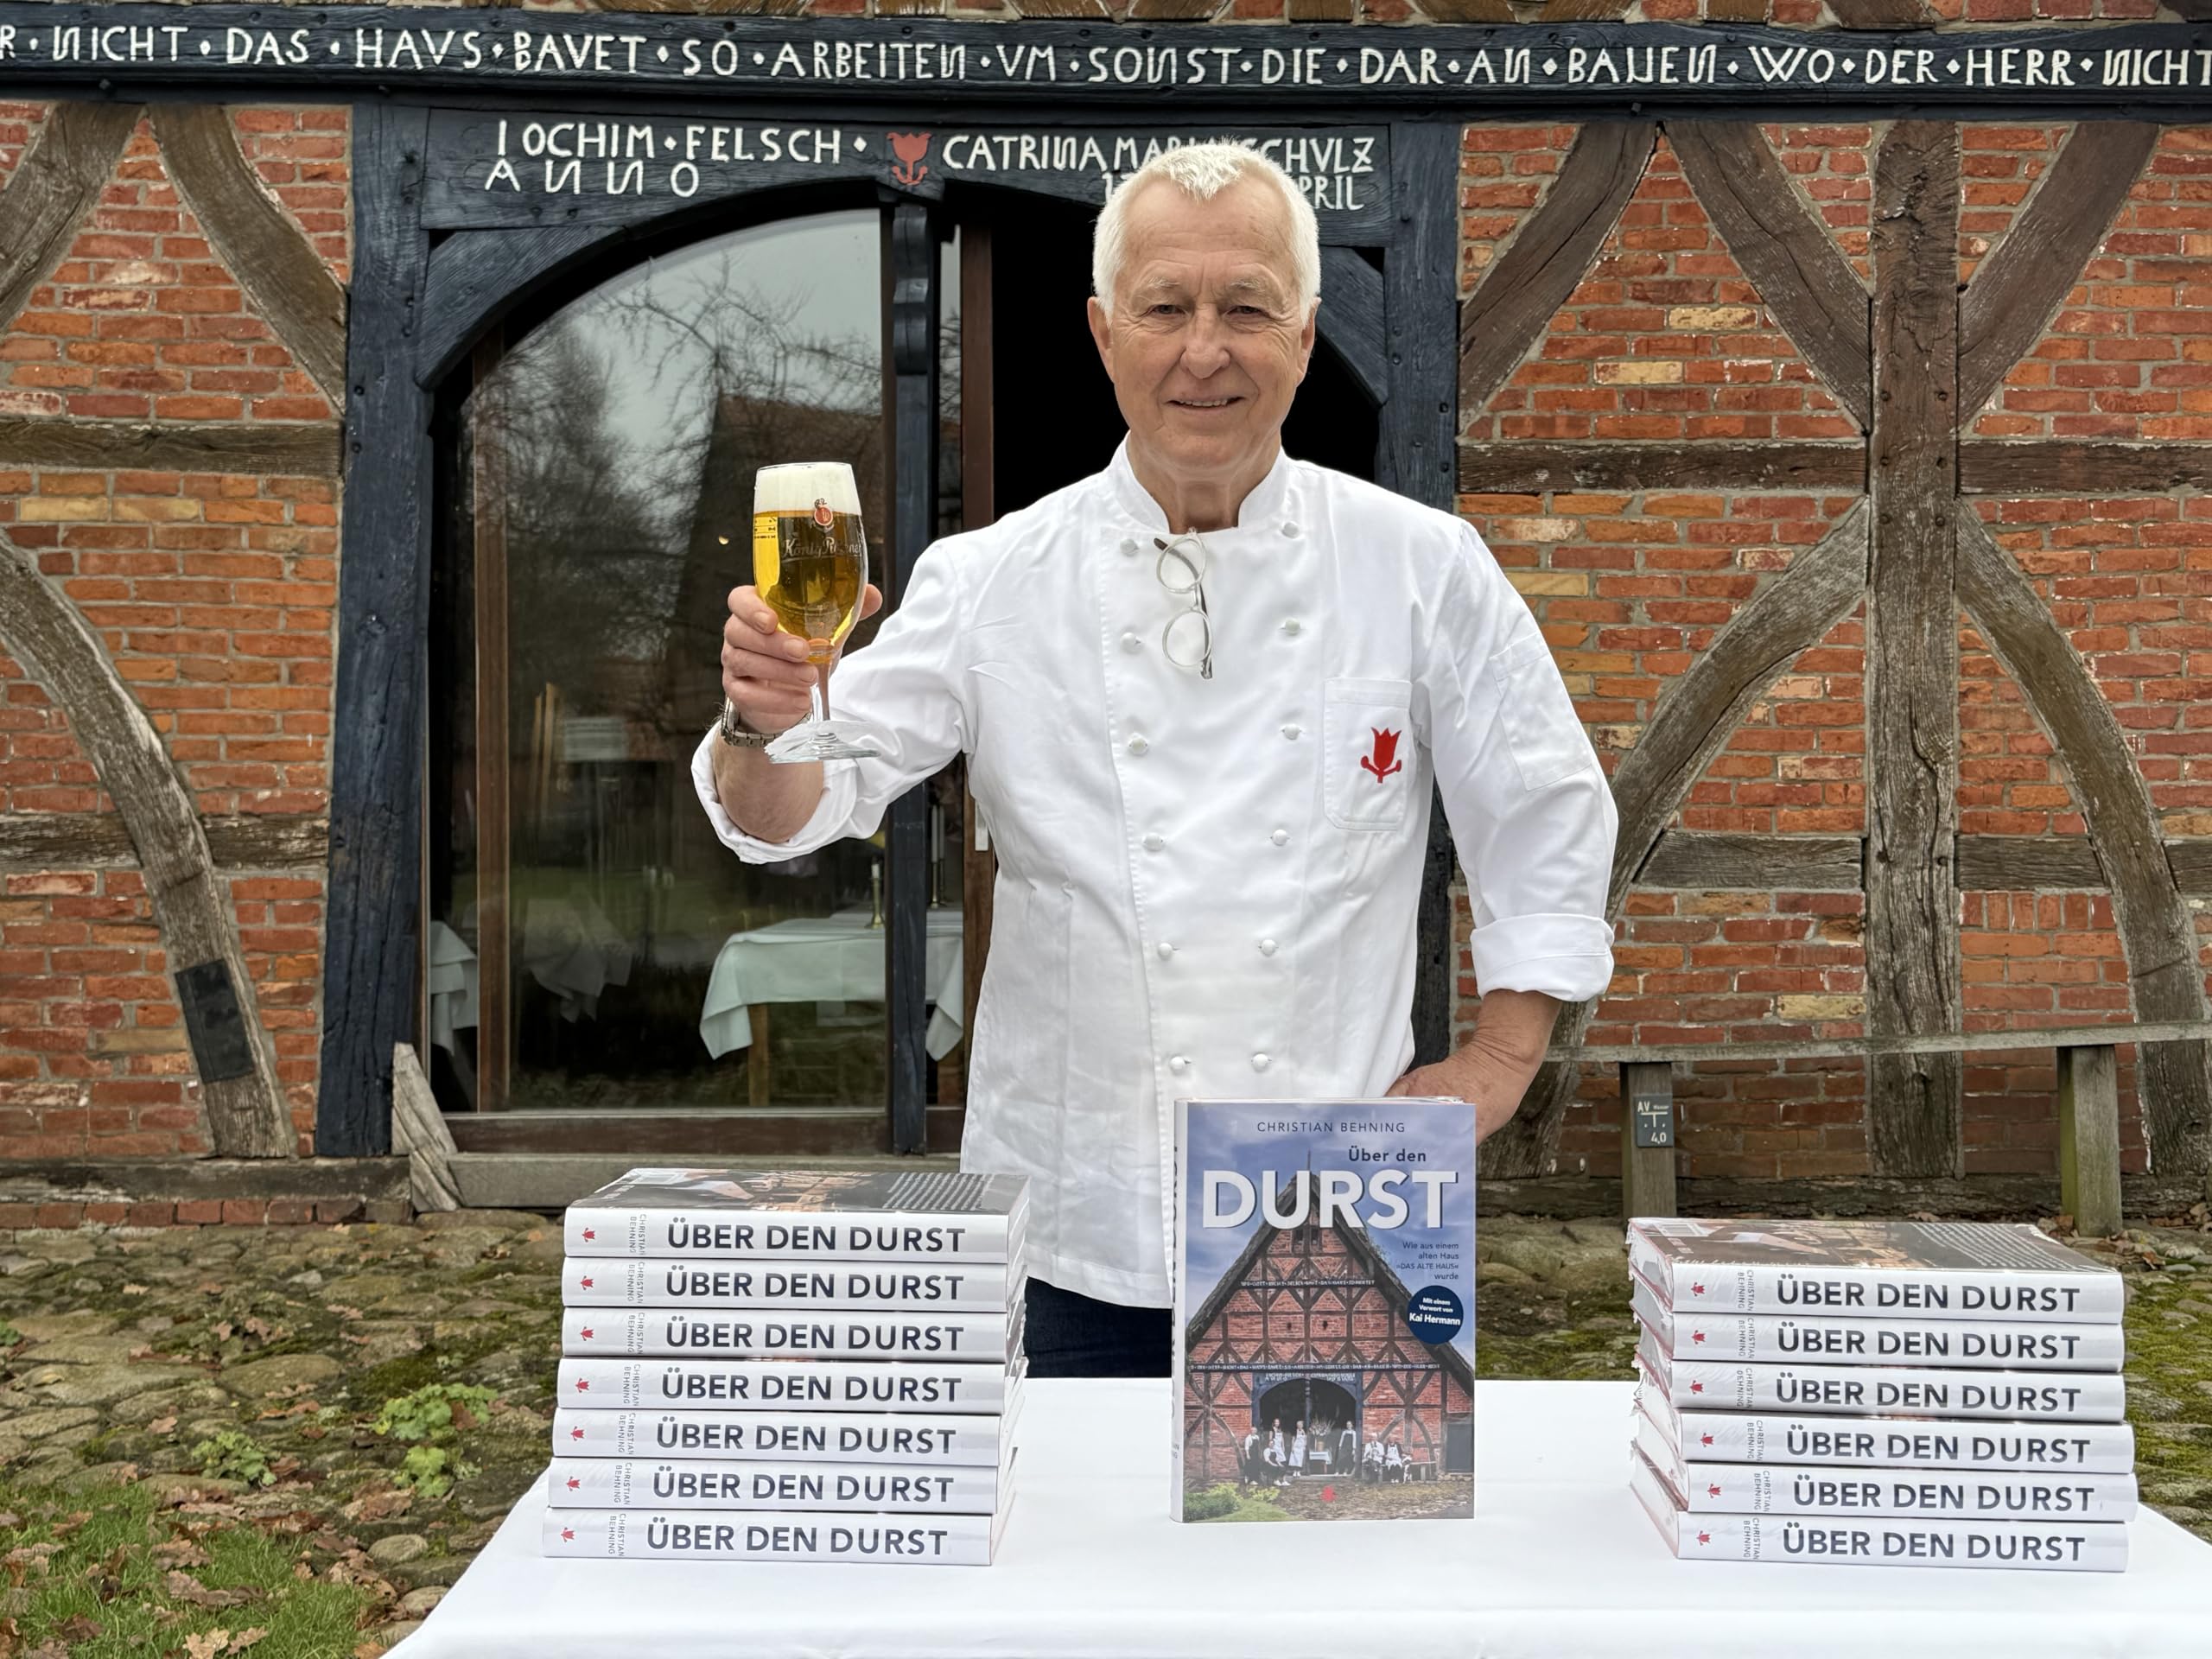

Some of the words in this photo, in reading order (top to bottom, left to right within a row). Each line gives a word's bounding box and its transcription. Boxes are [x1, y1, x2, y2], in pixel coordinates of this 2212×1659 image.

[226, 28, 308, 65] DAS
[683, 40, 737, 76] SO
[1262, 48, 1325, 84] DIE
[1361, 48, 1443, 84] DAR
[1748, 47, 1834, 83] WO
[1866, 49, 1938, 84] DER
[1966, 49, 2075, 86] HERR
[687, 126, 840, 164] FELSCH
[1247, 137, 1375, 173] CHVLZ
[1298, 175, 1364, 210] PRIL
[1637, 1100, 1650, 1112] AV
[1257, 1122, 1333, 1133] CHRISTIAN
[1341, 1122, 1405, 1133] BEHNING
[1348, 1146, 1389, 1162] Über
[1396, 1148, 1427, 1162] den
[1203, 1170, 1459, 1230] DURST
[668, 1217, 754, 1249] ÜBER
[766, 1225, 836, 1250] DEN
[849, 1226, 965, 1253] DURST
[666, 1264, 753, 1297] ÜBER
[765, 1273, 835, 1299] DEN
[848, 1274, 964, 1300] DURST
[1777, 1273, 1865, 1306] ÜBER
[1877, 1283, 1948, 1309] DEN
[1962, 1285, 2081, 1313] DURST
[666, 1315, 753, 1348] ÜBER
[765, 1324, 835, 1349] DEN
[848, 1325, 964, 1351] DURST
[1409, 1313, 1422, 1322] Kai
[1424, 1314, 1461, 1325] Hermann
[1778, 1321, 1866, 1354] ÜBER
[1878, 1331, 1949, 1357] DEN
[1962, 1333, 2081, 1359] DURST
[662, 1367, 749, 1400] ÜBER
[761, 1375, 832, 1401] DEN
[845, 1376, 962, 1402] DURST
[1777, 1371, 1864, 1406] ÜBER
[1877, 1382, 1948, 1408] DEN
[1962, 1385, 2082, 1412] DURST
[657, 1416, 744, 1449] ÜBER
[755, 1425, 826, 1451] DEN
[839, 1427, 957, 1454] DURST
[1787, 1424, 1875, 1458] ÜBER
[1887, 1434, 1959, 1460] DEN
[1972, 1437, 2091, 1463] DURST
[653, 1465, 741, 1499] ÜBER
[753, 1474, 823, 1500] DEN
[836, 1475, 954, 1503] DURST
[1794, 1474, 1881, 1508] ÜBER
[1893, 1484, 1964, 1510] DEN
[1977, 1485, 2095, 1511] DURST
[647, 1516, 734, 1550] ÜBER
[747, 1526, 817, 1552] DEN
[830, 1528, 948, 1555] DURST
[1783, 1522, 1871, 1555] ÜBER
[1883, 1532, 1954, 1558] DEN
[1967, 1535, 2086, 1561] DURST
